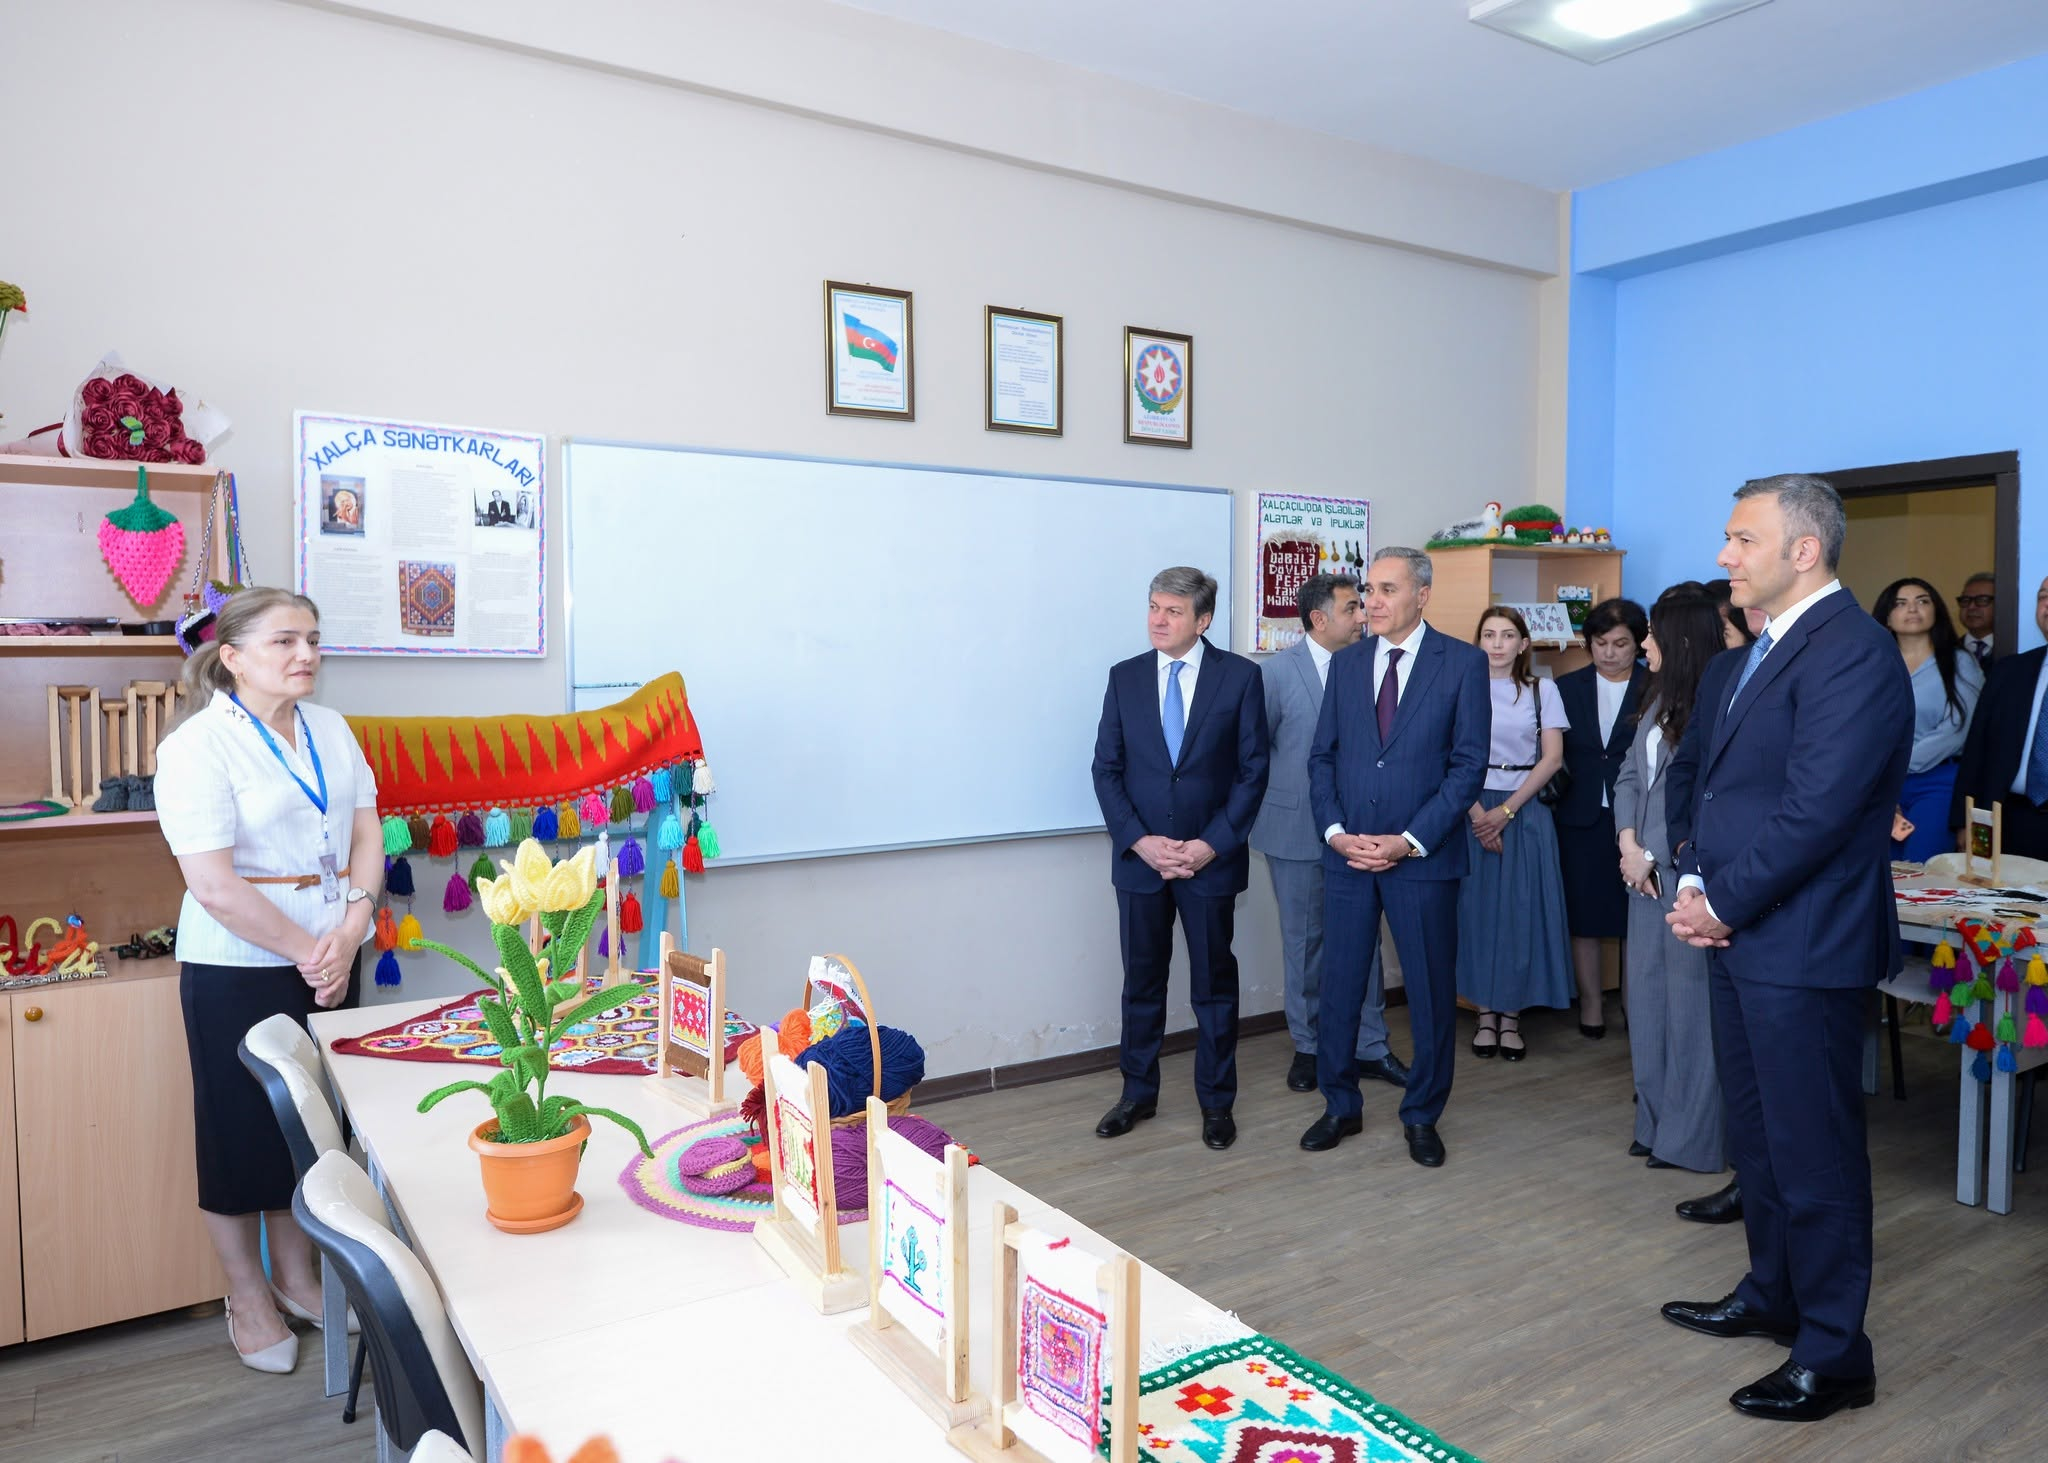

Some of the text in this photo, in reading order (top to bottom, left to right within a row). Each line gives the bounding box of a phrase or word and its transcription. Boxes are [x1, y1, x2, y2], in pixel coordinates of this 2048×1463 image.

[308, 429, 536, 487] XALÇA SƏNƏTKARLARI
[1263, 513, 1303, 525] ALƏTLƏR
[1311, 517, 1322, 526] VƏ
[1274, 586, 1299, 597] TƏH
